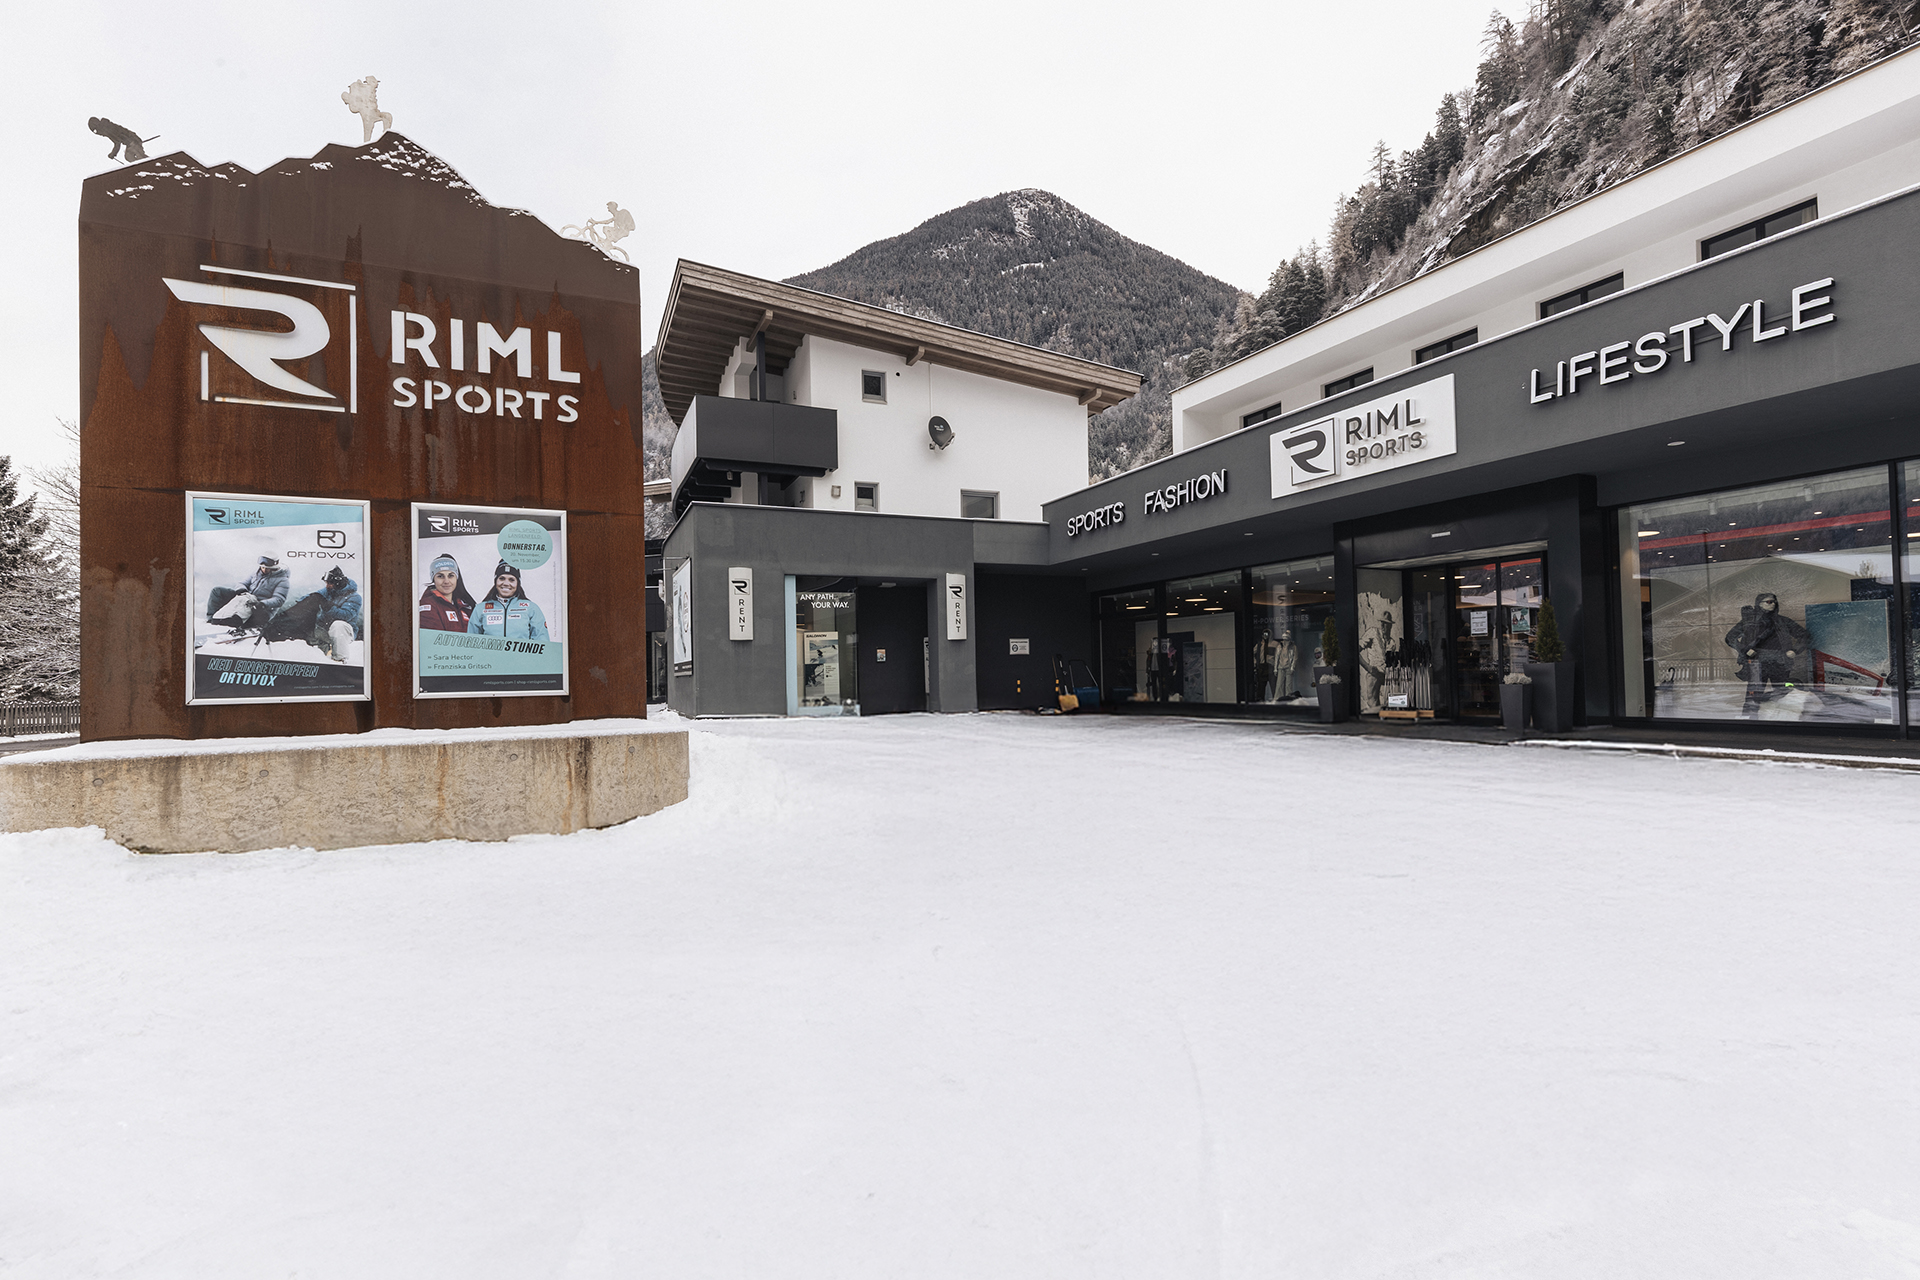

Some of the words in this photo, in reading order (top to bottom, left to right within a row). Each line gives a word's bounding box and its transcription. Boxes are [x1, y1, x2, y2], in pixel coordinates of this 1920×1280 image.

[391, 310, 581, 383] RIML
[1530, 277, 1837, 404] LIFESTYLE
[392, 376, 580, 423] SPORTS
[1346, 399, 1422, 444] RIML
[1346, 431, 1423, 466] SPORTS
[1067, 501, 1125, 537] SPORTS
[1144, 468, 1228, 515] FASHION
[234, 509, 265, 519] RIML
[452, 518, 479, 528] RIML
[452, 526, 479, 534] SPORTS
[287, 551, 355, 560] ORTOVOX
[503, 542, 547, 552] DONNERSTAG.
[811, 601, 831, 609] YOUR
[738, 598, 746, 633] RENT
[1285, 613, 1310, 623] SERIES
[207, 657, 233, 671] NEU
[234, 659, 320, 678] EINGETROFFEN
[219, 671, 278, 687] ORTOVOX
